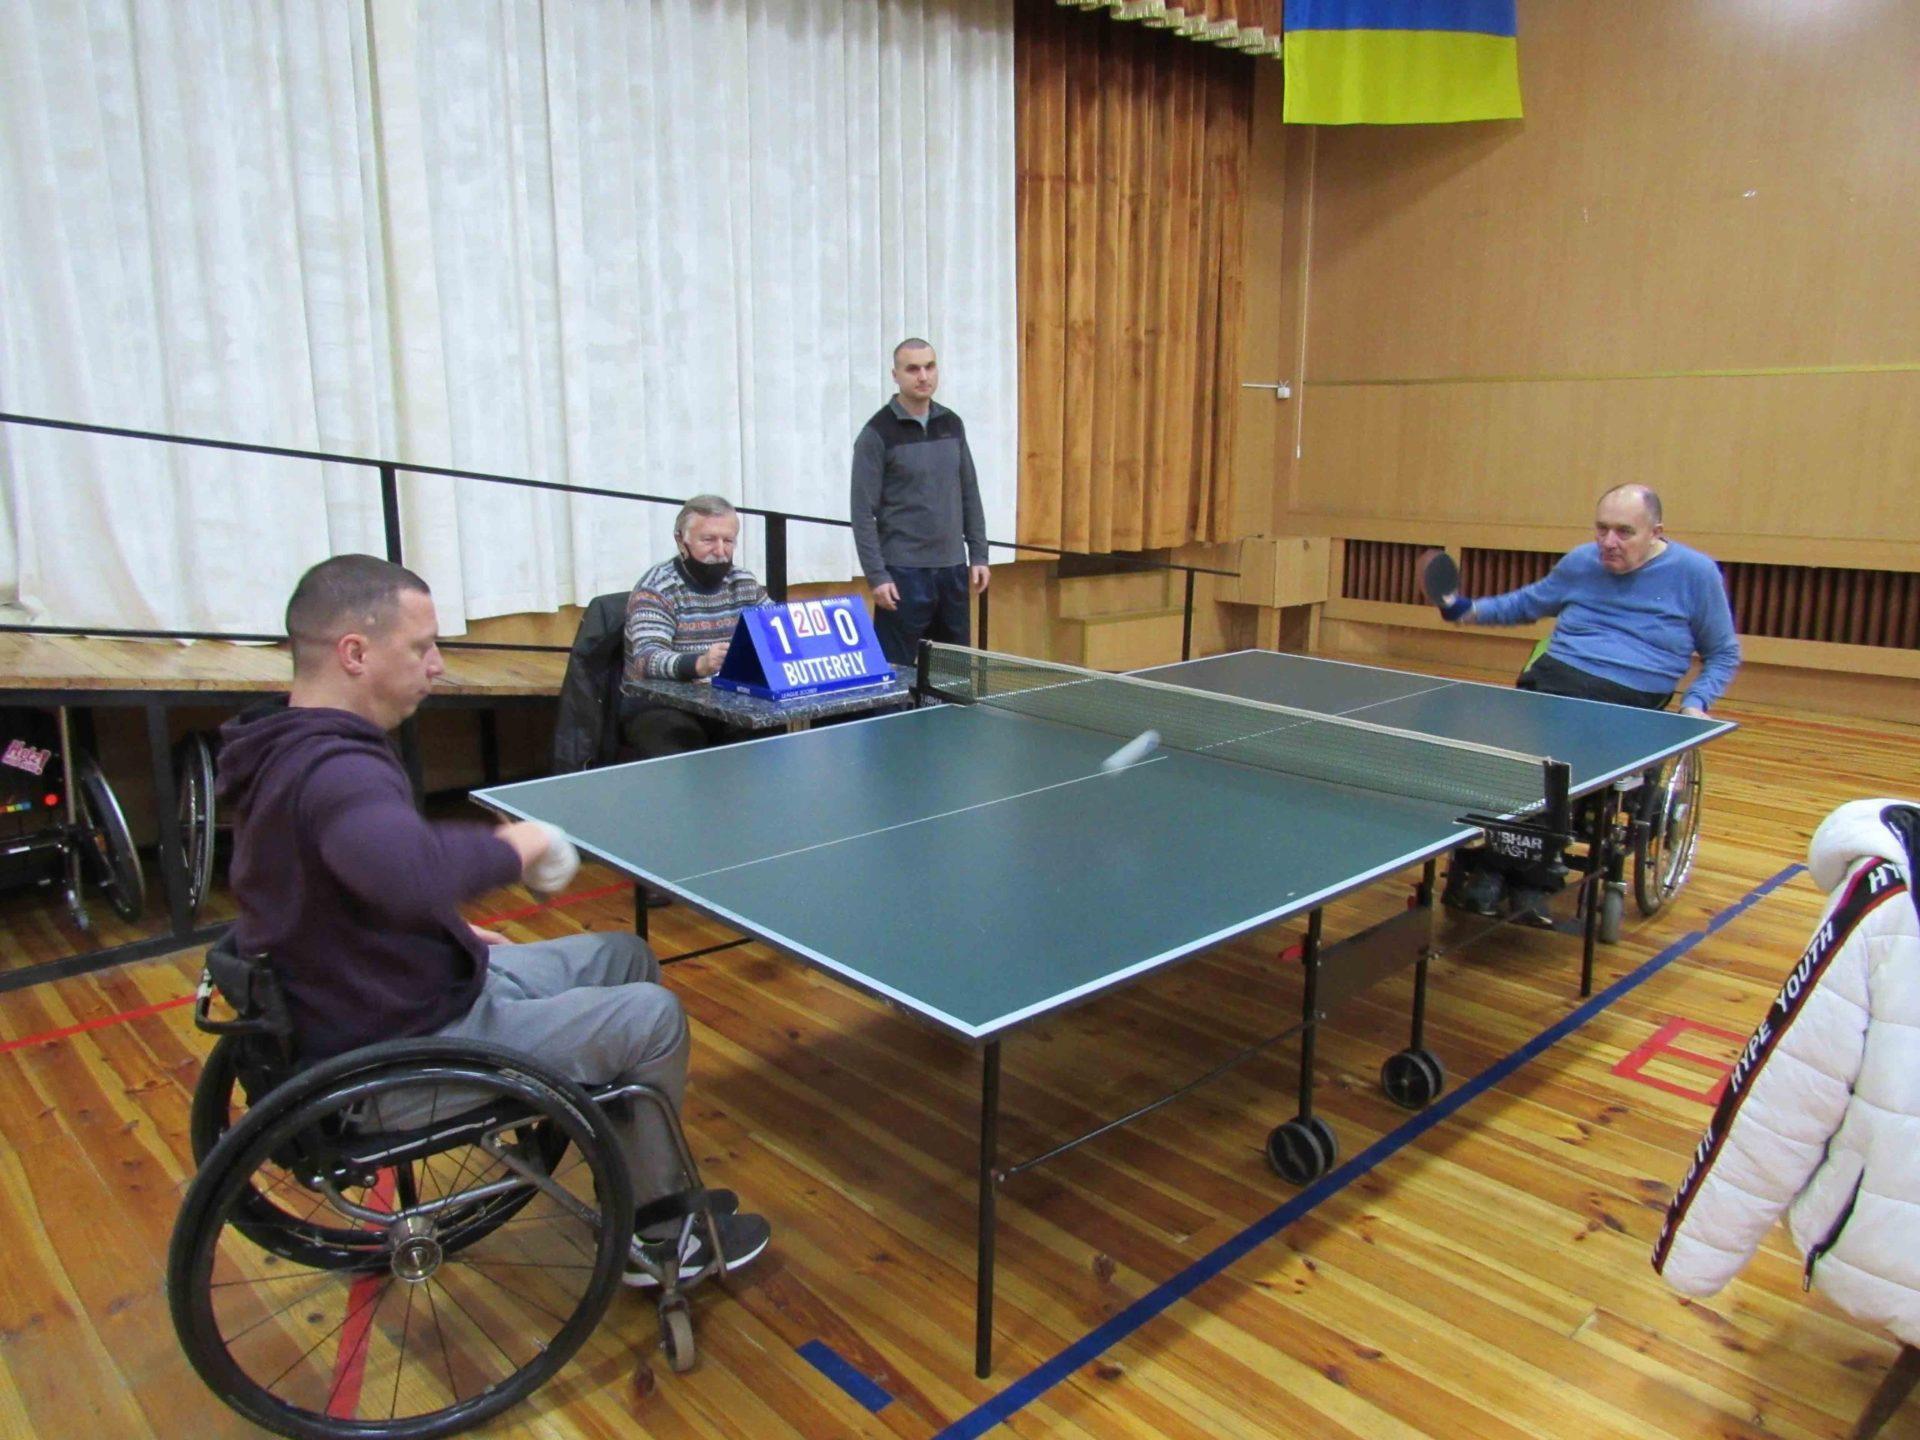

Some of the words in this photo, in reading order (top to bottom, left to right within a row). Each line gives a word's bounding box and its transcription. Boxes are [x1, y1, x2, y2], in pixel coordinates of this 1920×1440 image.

[769, 615, 793, 655] 1
[833, 607, 860, 646] 0
[782, 650, 868, 687] BUTTERFLY
[1731, 1019, 1772, 1094] HYPE
[1775, 920, 1834, 1014] YOUTH
